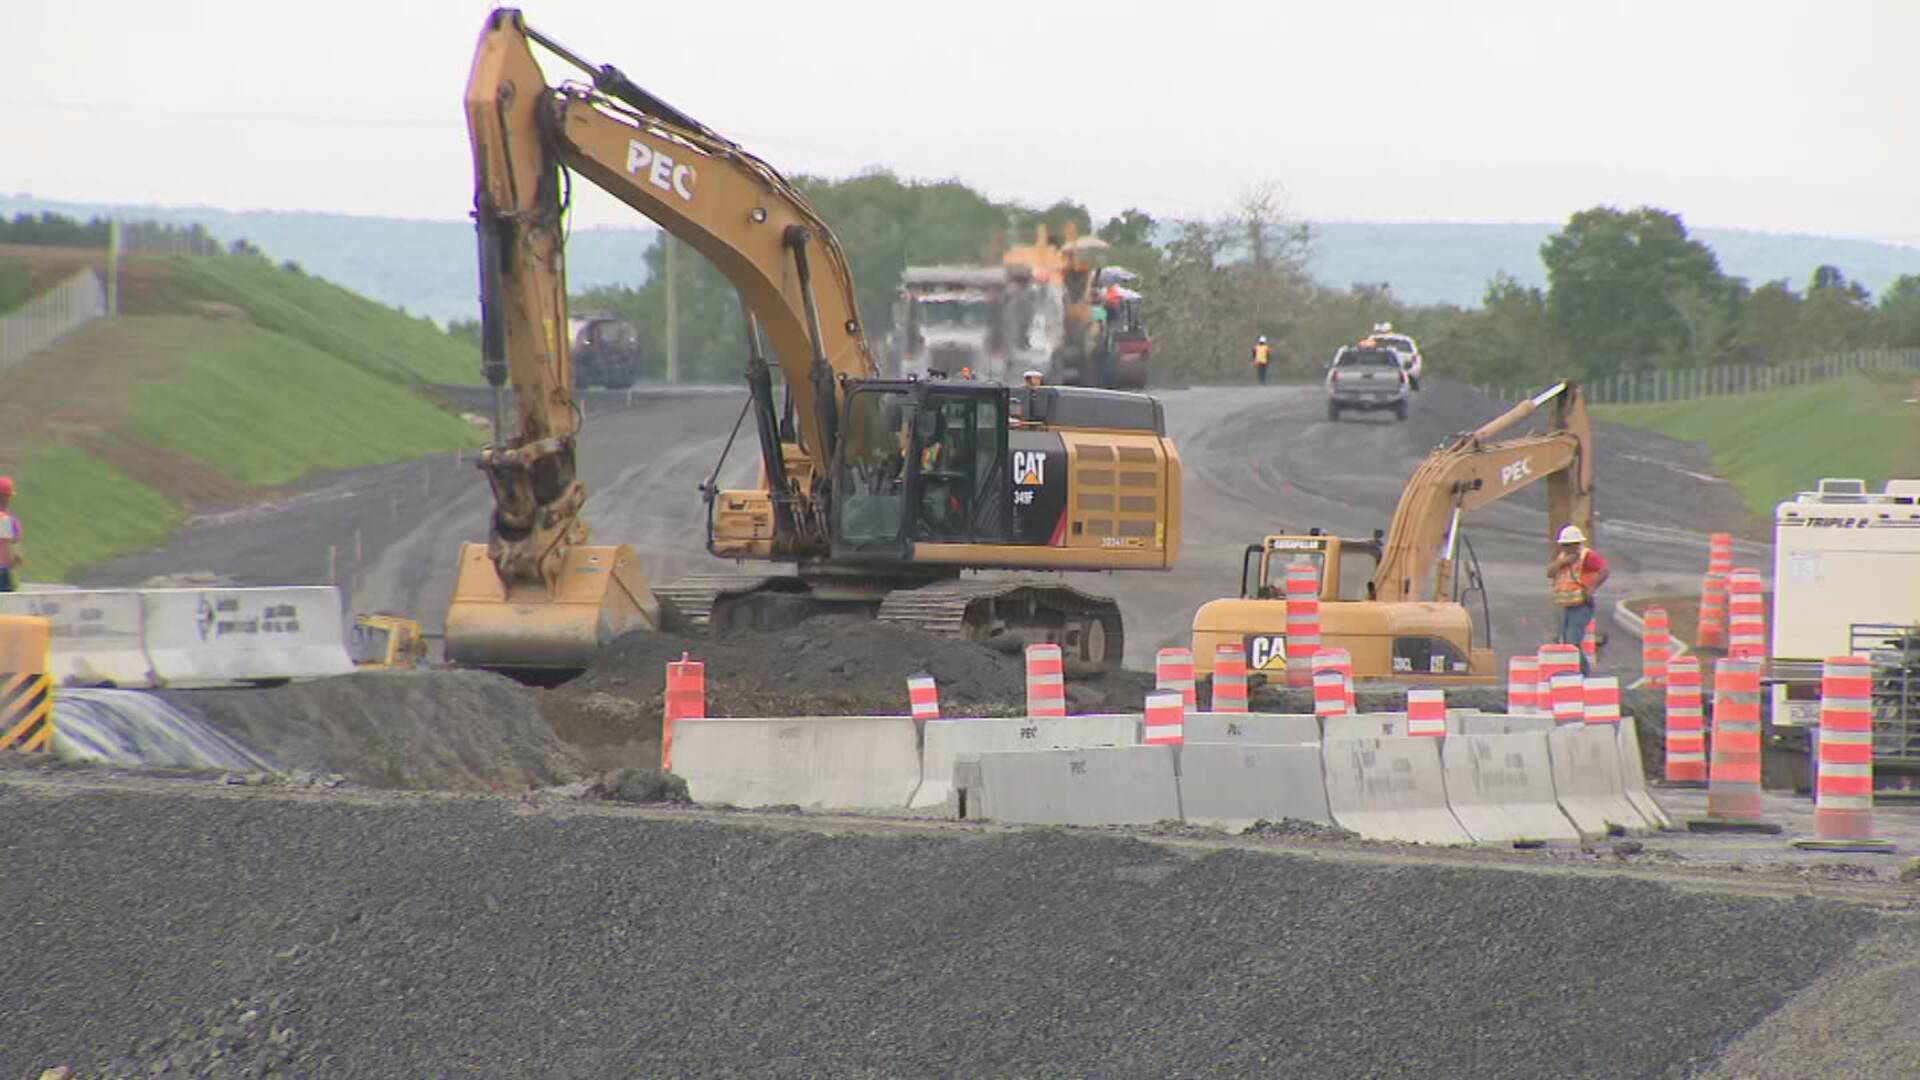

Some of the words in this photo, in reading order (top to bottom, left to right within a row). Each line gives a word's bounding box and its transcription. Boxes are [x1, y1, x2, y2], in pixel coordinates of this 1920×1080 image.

[626, 138, 696, 202] PEC
[1013, 451, 1046, 485] CAT
[1501, 456, 1533, 486] PEC
[1013, 490, 1034, 505] 349F
[1806, 517, 1855, 528] TRIPLE
[1251, 637, 1286, 670] CA
